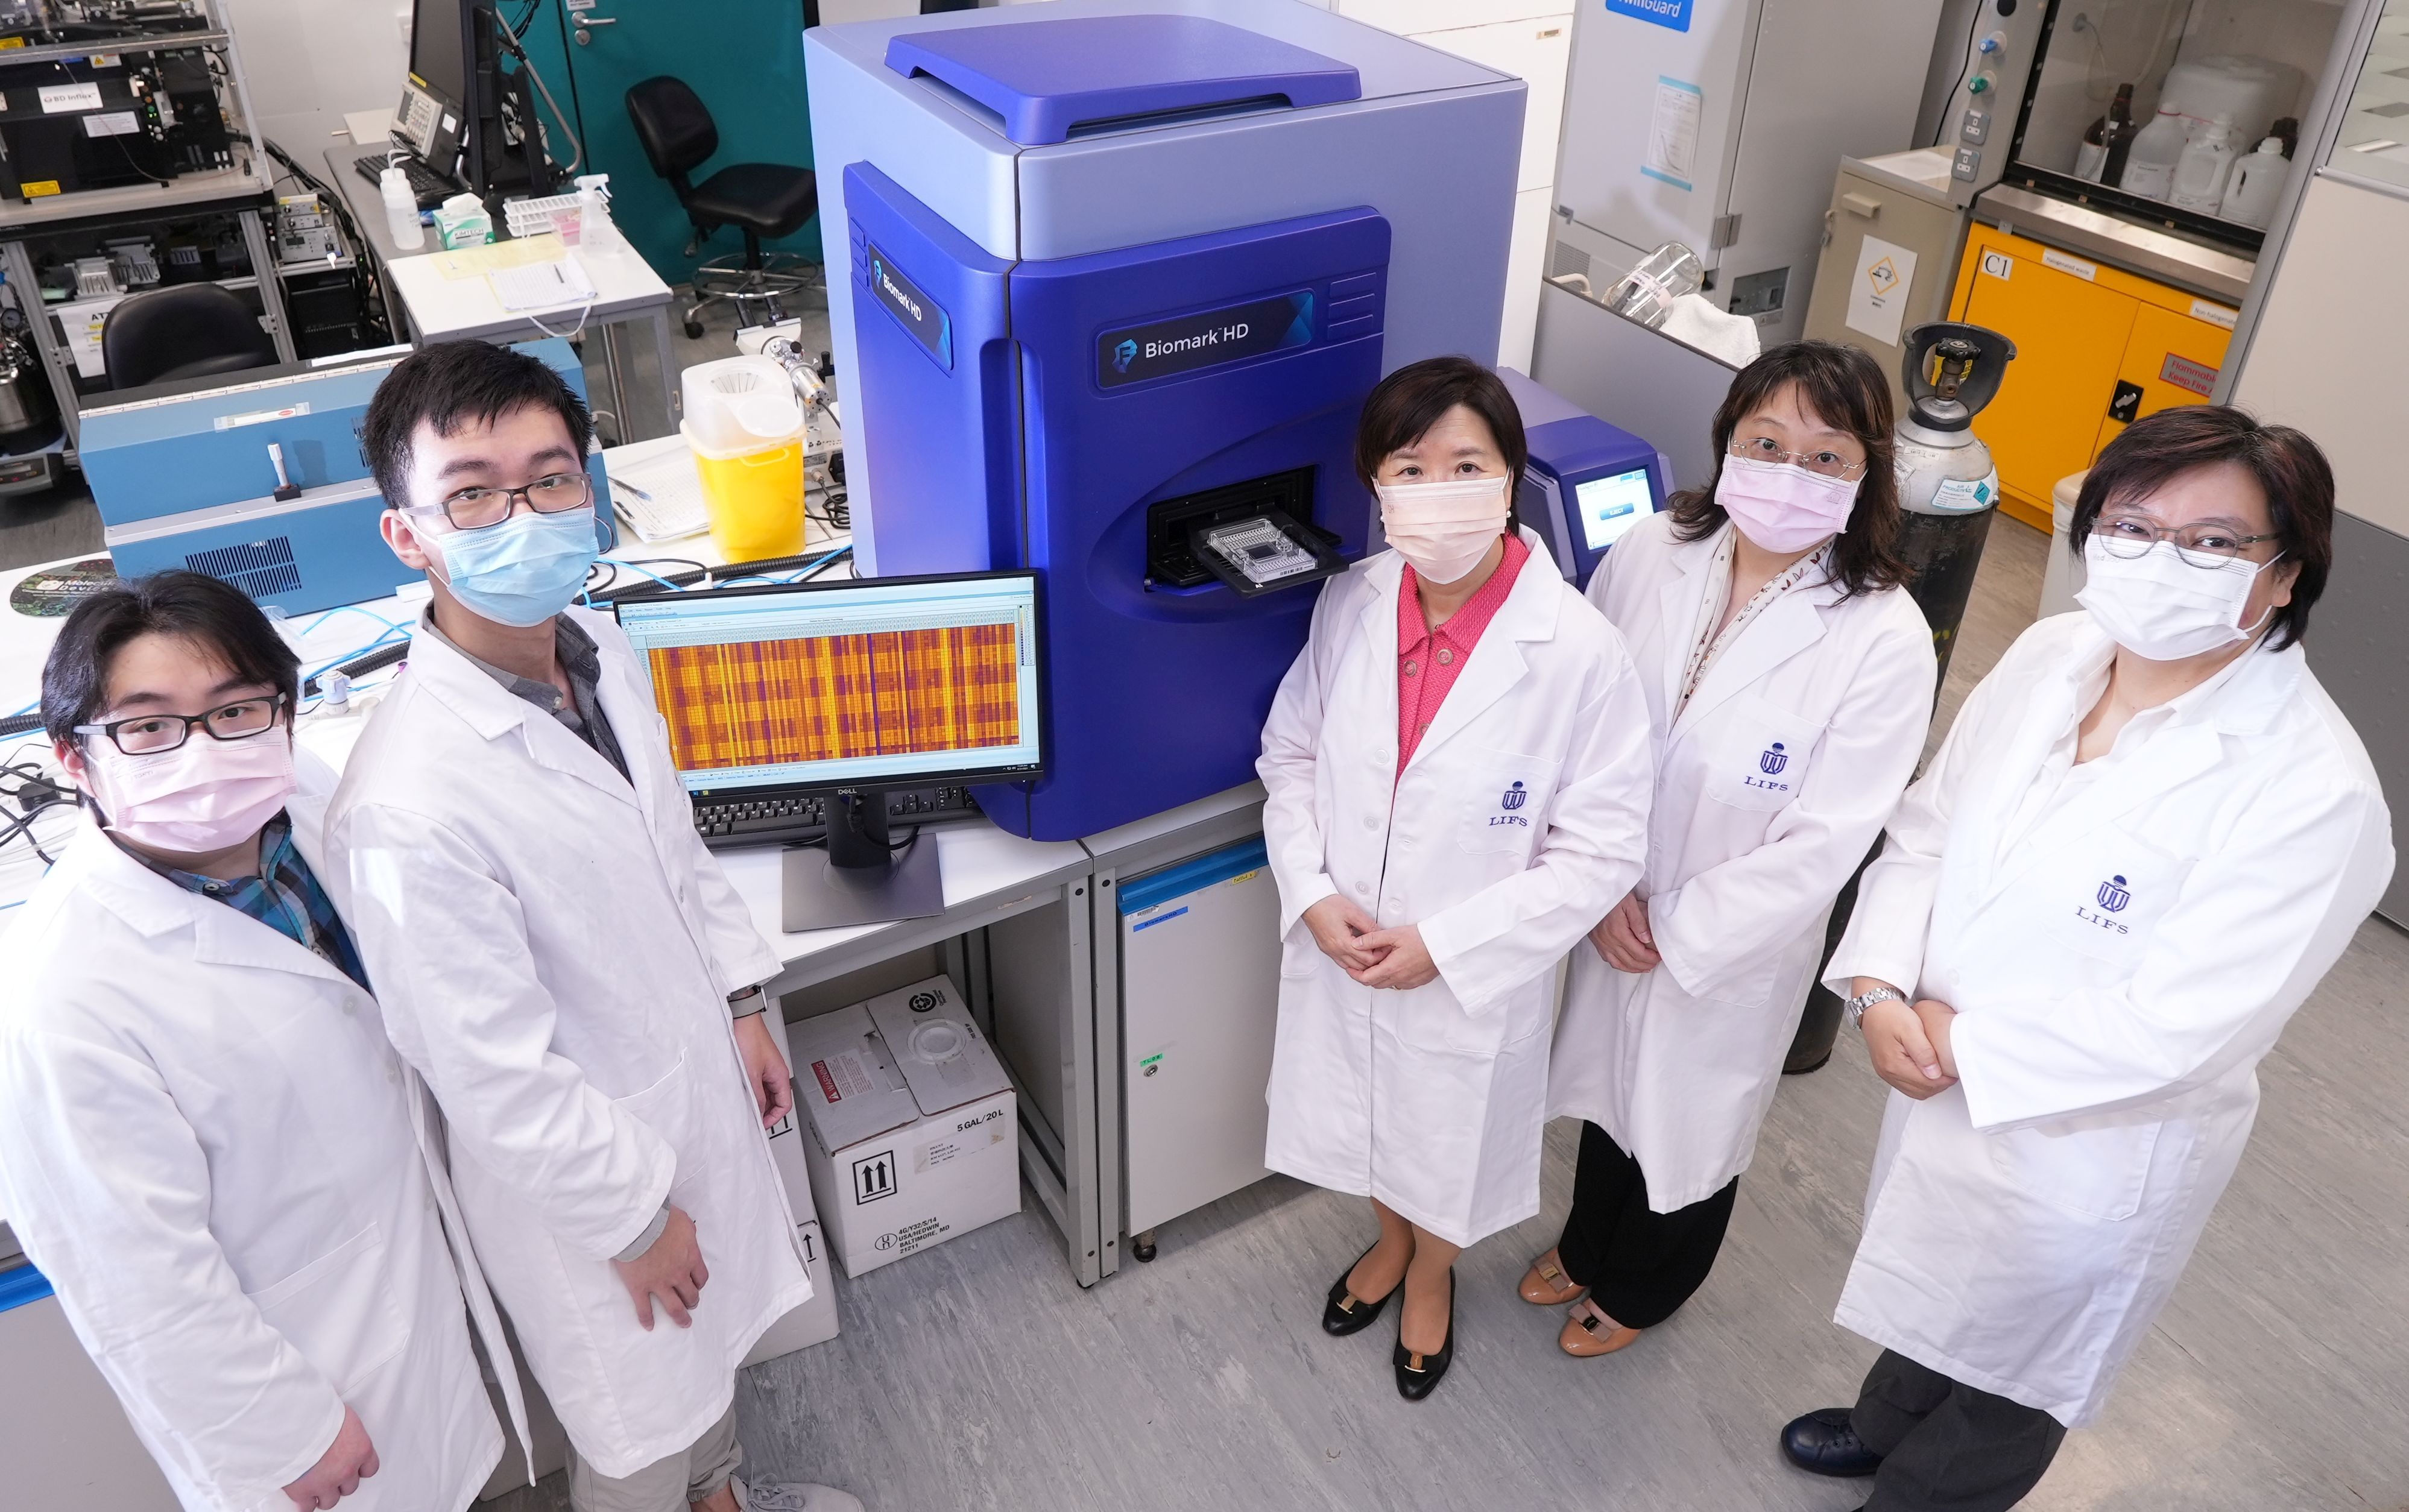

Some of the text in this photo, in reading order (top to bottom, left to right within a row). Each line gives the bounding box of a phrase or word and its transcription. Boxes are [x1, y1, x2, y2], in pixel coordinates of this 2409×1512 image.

[455, 227, 484, 238] KIMTECH
[1985, 255, 2008, 277] C1
[911, 300, 922, 322] HD
[1223, 323, 1249, 342] HD
[2168, 371, 2191, 386] Keep
[2191, 379, 2208, 392] Fire
[1744, 775, 1789, 792] LIFS
[1489, 816, 1528, 827] LIFS
[2075, 906, 2128, 934] LIFS
[816, 1061, 835, 1093] WARNING
[898, 1217, 937, 1235] 4G/Y32/S/14
[898, 1223, 939, 1241] USA/HEDWIN
[939, 1224, 950, 1233] MD
[900, 1243, 918, 1254] 21211
